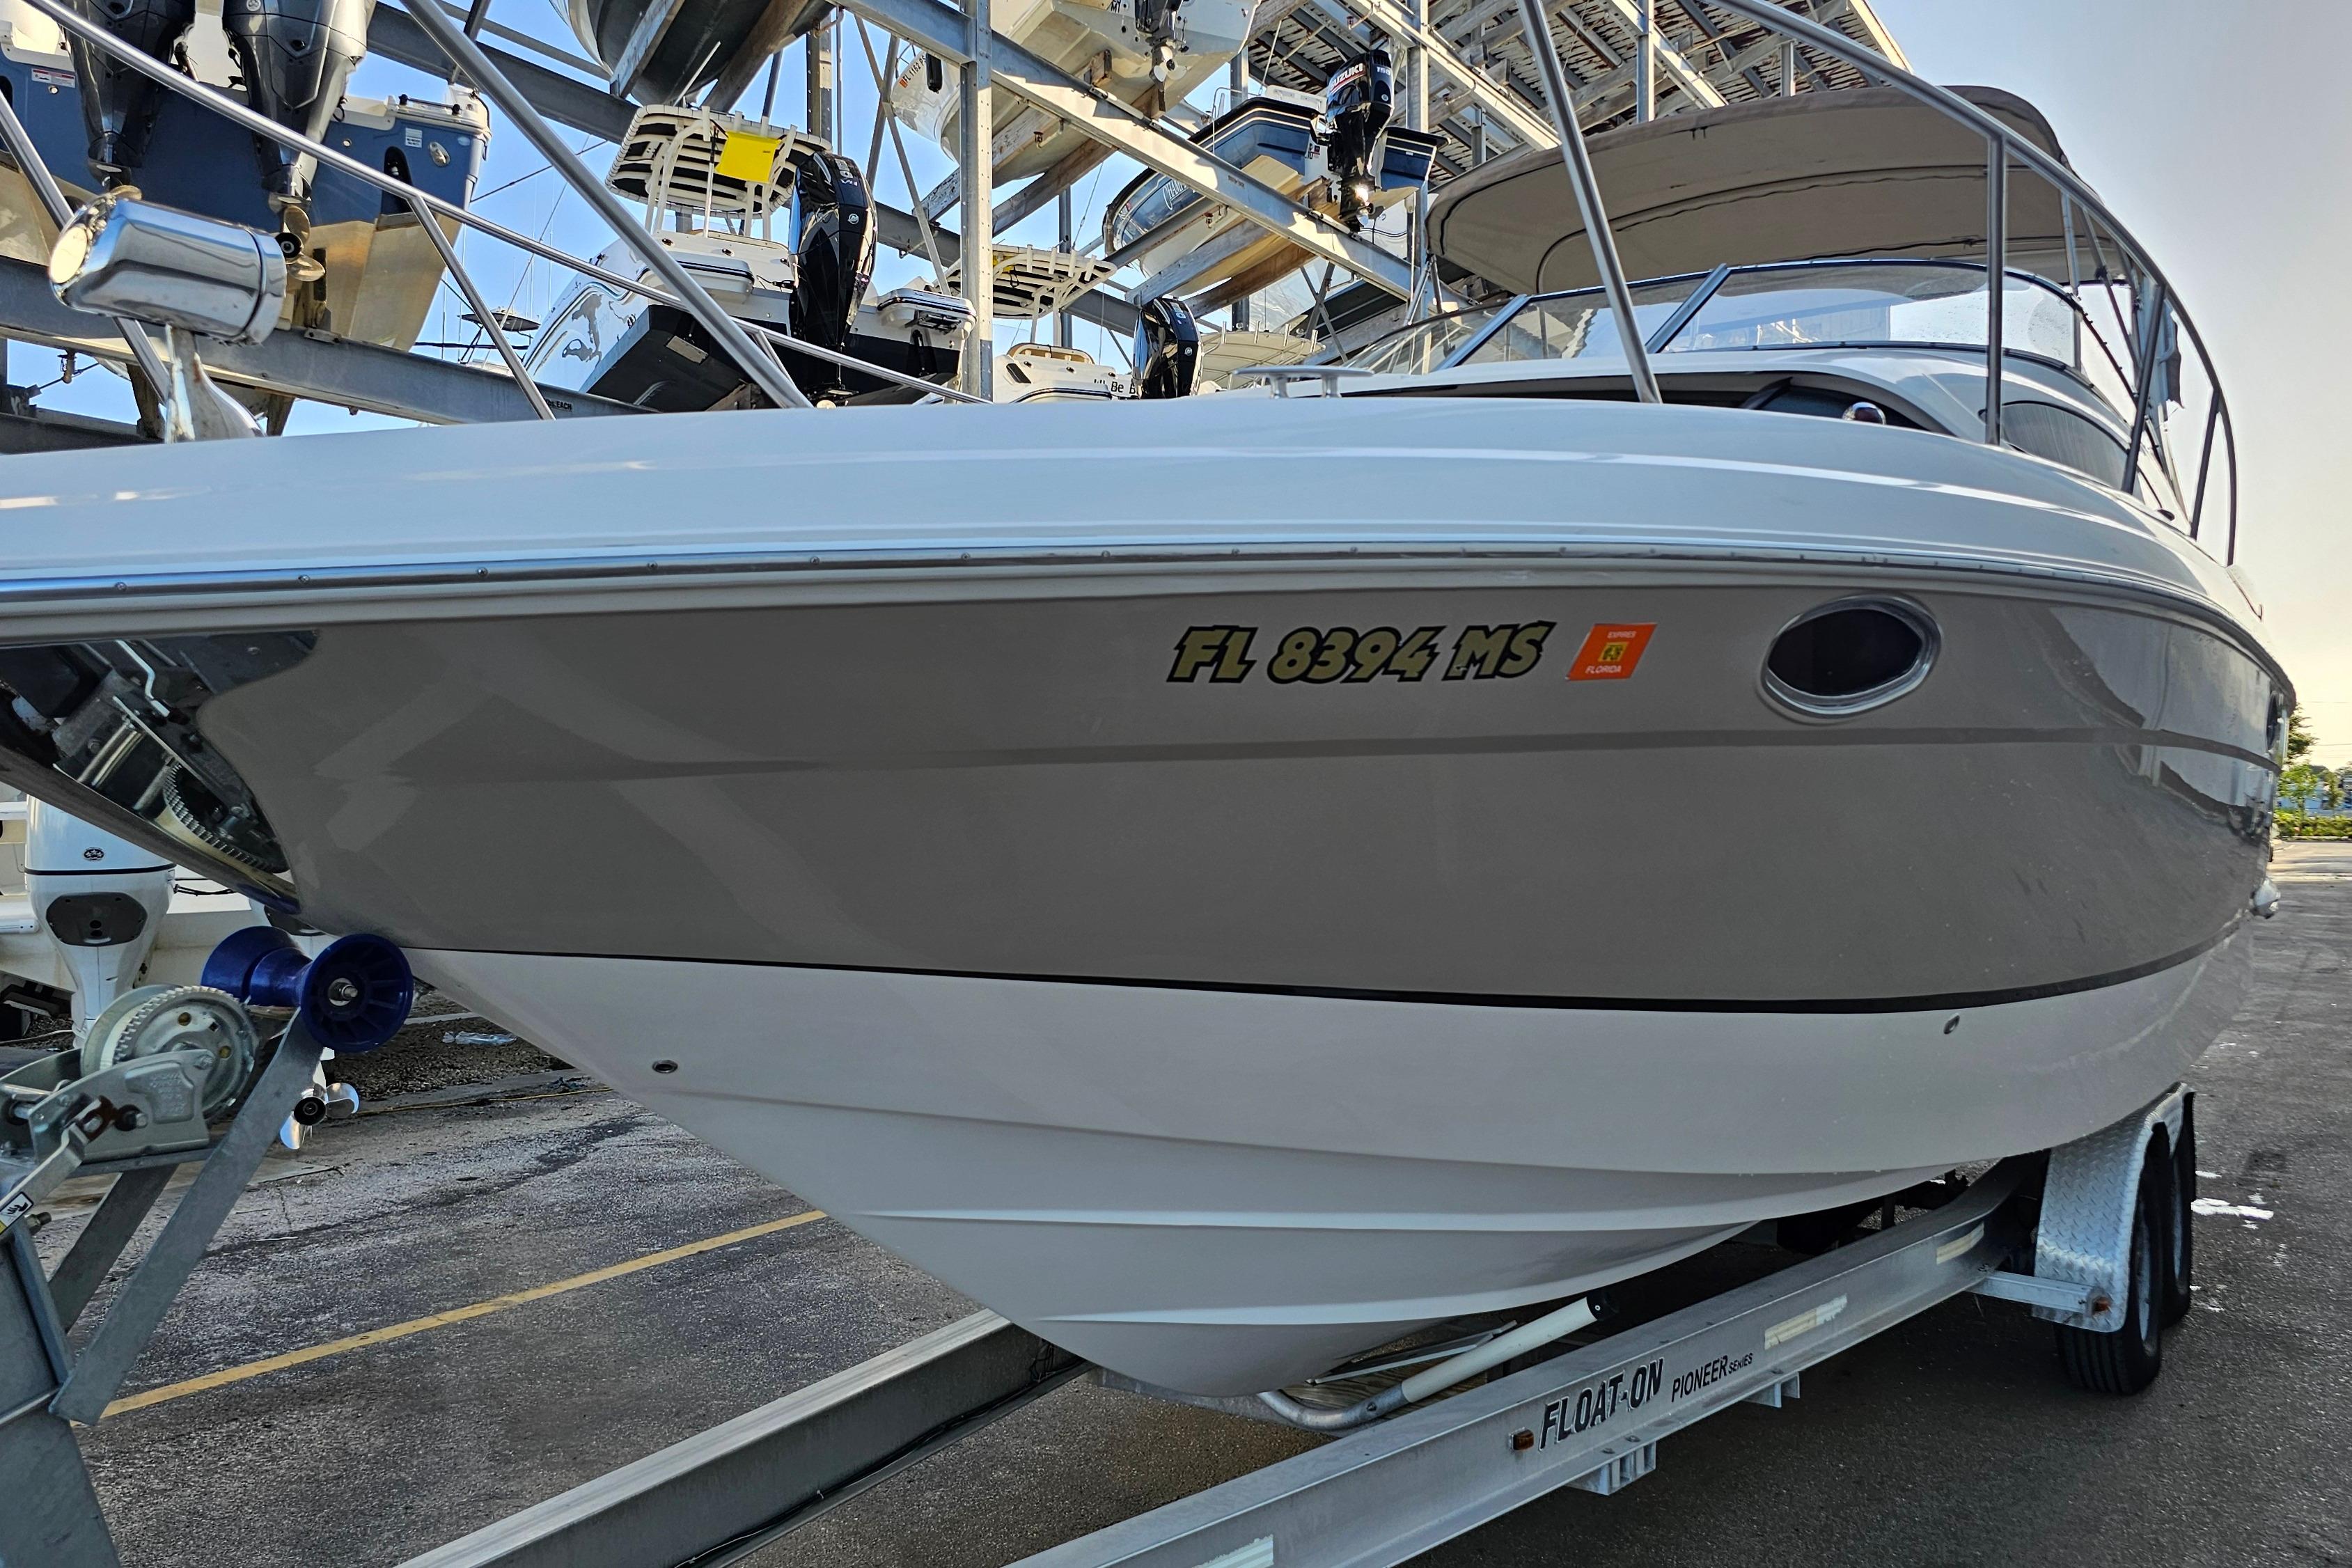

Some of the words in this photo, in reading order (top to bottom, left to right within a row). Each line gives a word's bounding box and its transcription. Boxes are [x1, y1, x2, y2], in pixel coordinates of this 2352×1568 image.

[1377, 66, 1391, 76] 150
[902, 74, 911, 83] FL
[1111, 381, 1124, 393] Be
[1166, 625, 1258, 683] FL
[1267, 626, 1447, 684] 8394
[1441, 620, 1557, 681] MS
[1585, 666, 1622, 674] FLORIDA
[1539, 1358, 1664, 1451] FLOAT-ON
[1671, 1355, 1728, 1402] PIONEER
[1728, 1353, 1753, 1374] SERIES
